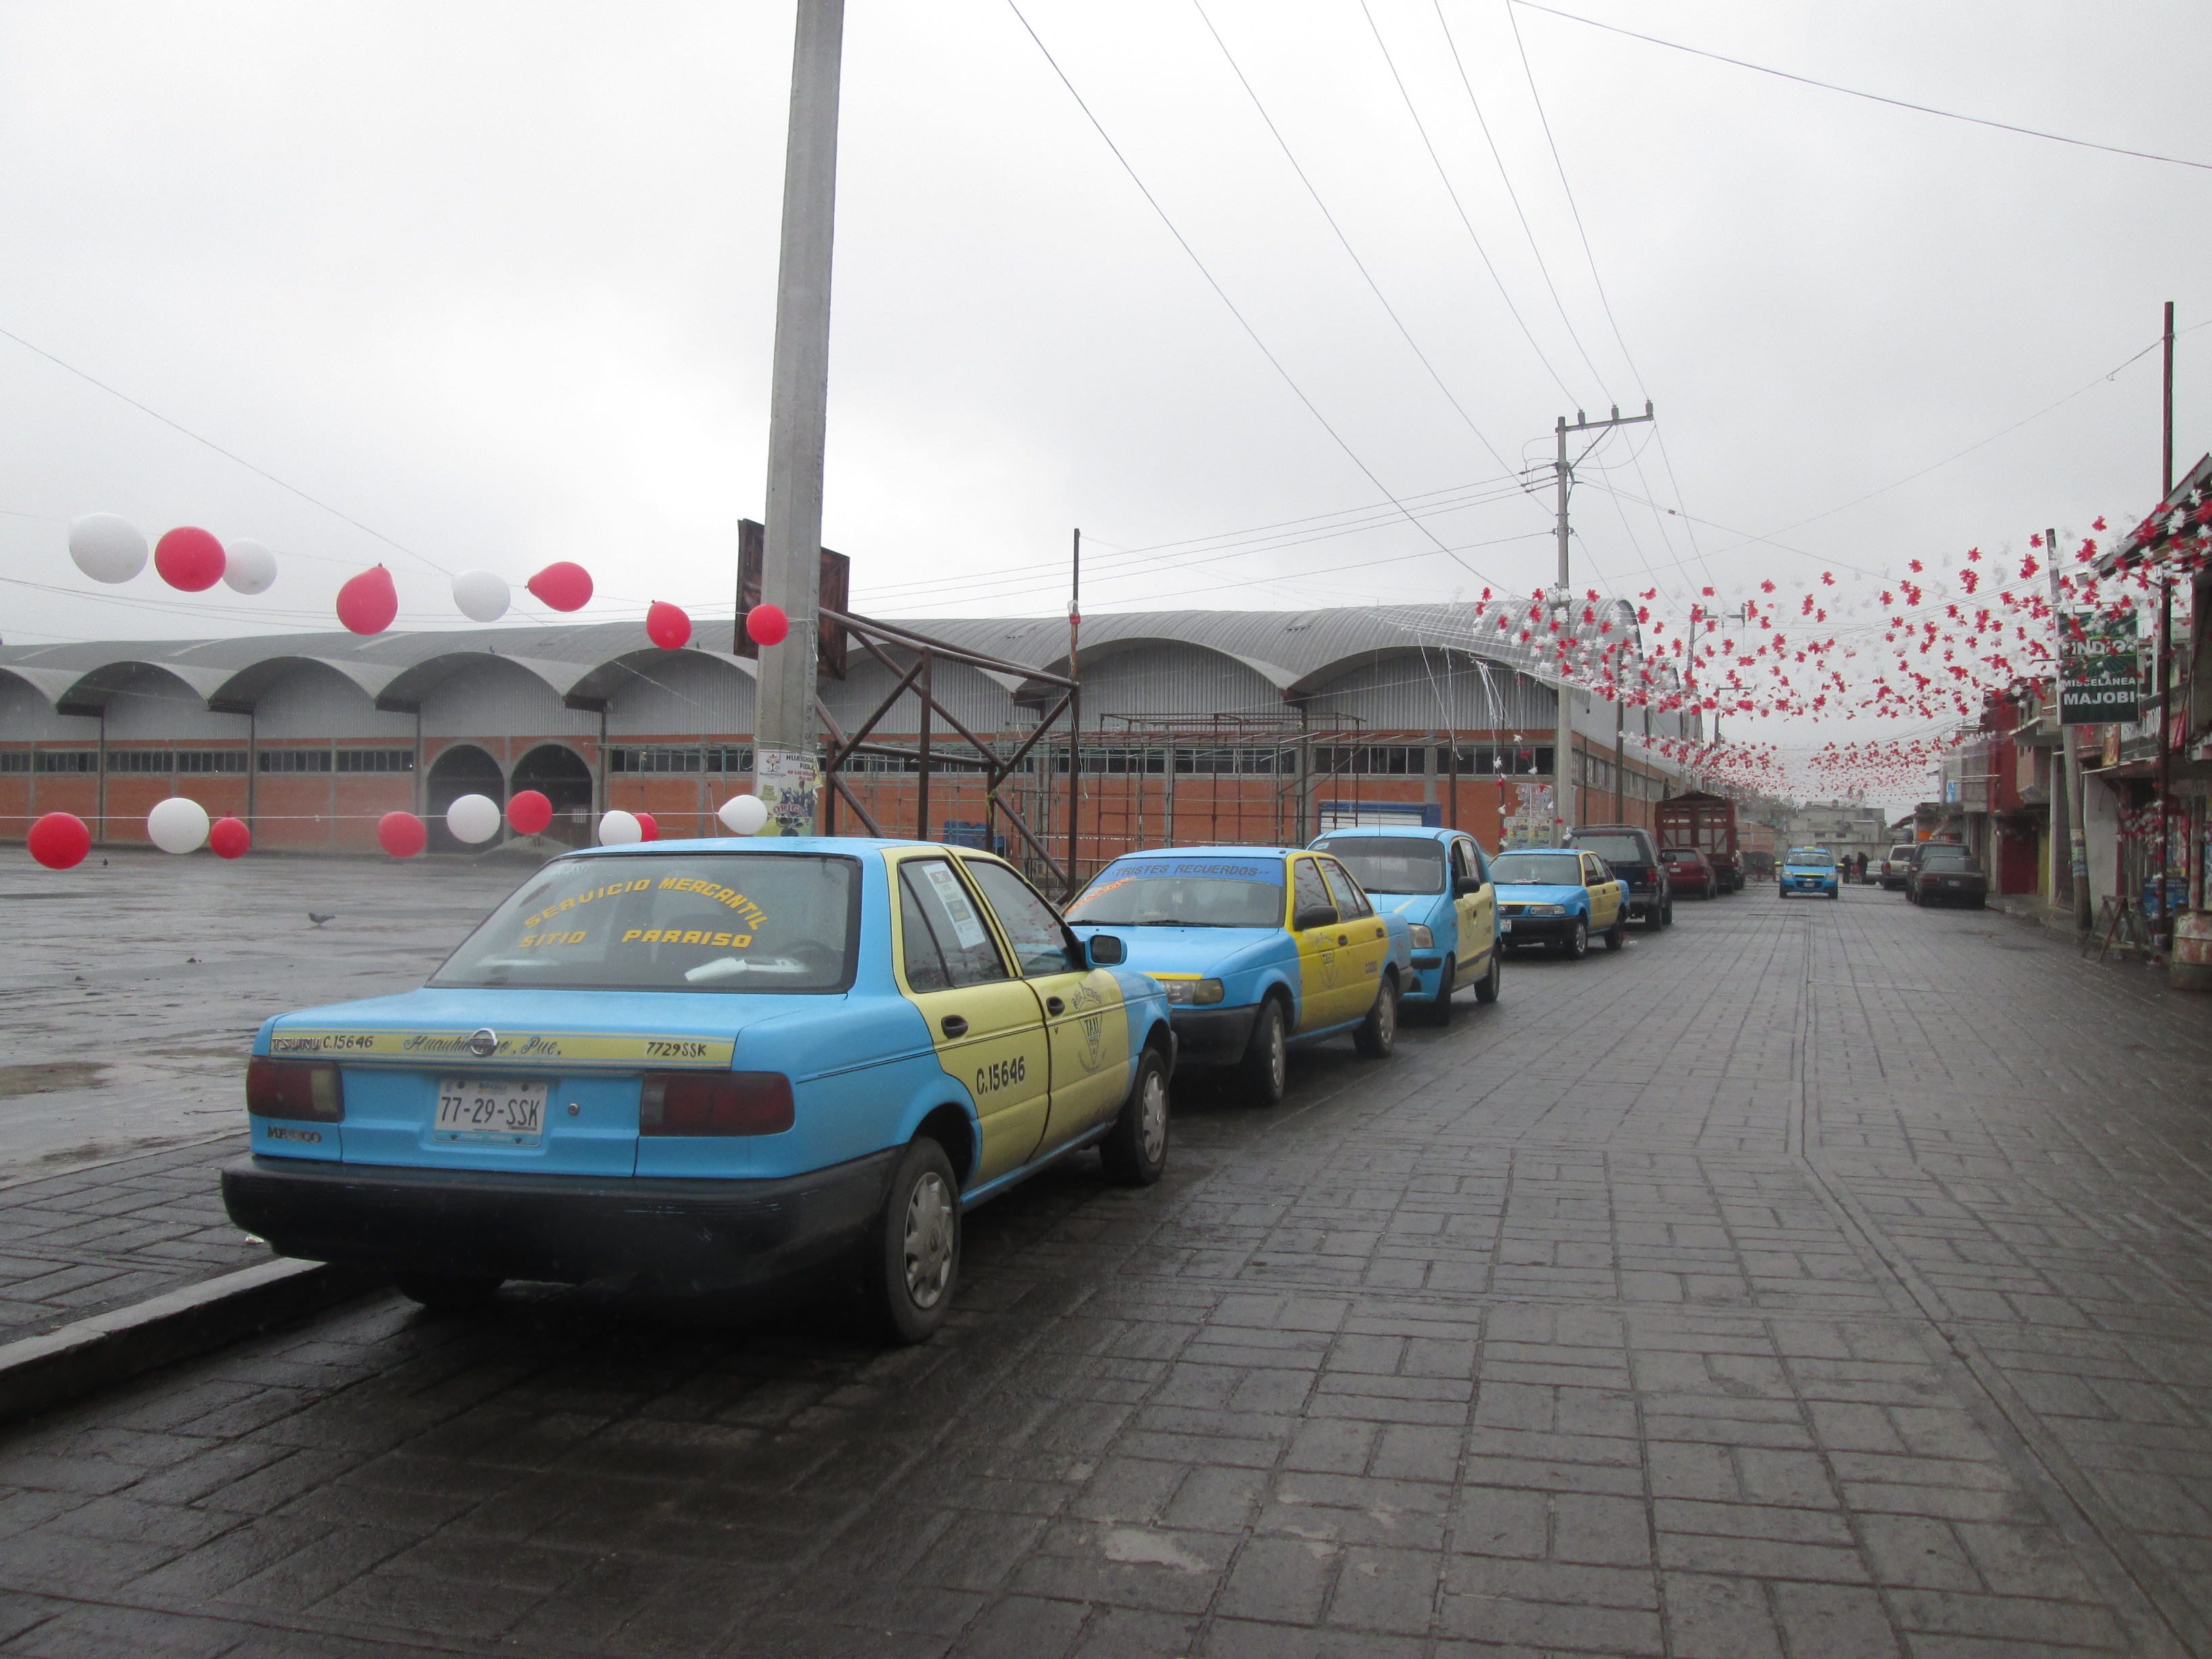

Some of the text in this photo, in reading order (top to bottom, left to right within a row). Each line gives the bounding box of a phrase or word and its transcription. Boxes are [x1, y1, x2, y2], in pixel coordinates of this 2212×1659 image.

[2064, 691, 2135, 705] MAJOBI
[1115, 864, 1258, 876] TRISTES RECUERDOS
[658, 878, 768, 930] MERCANTIL
[518, 930, 753, 948] SITIO PARAISO
[1084, 1017, 1099, 1037] TAXI
[323, 1036, 374, 1049] C.15646
[977, 1055, 1025, 1094] C.15646
[441, 1097, 540, 1126] 77-29-SSK
